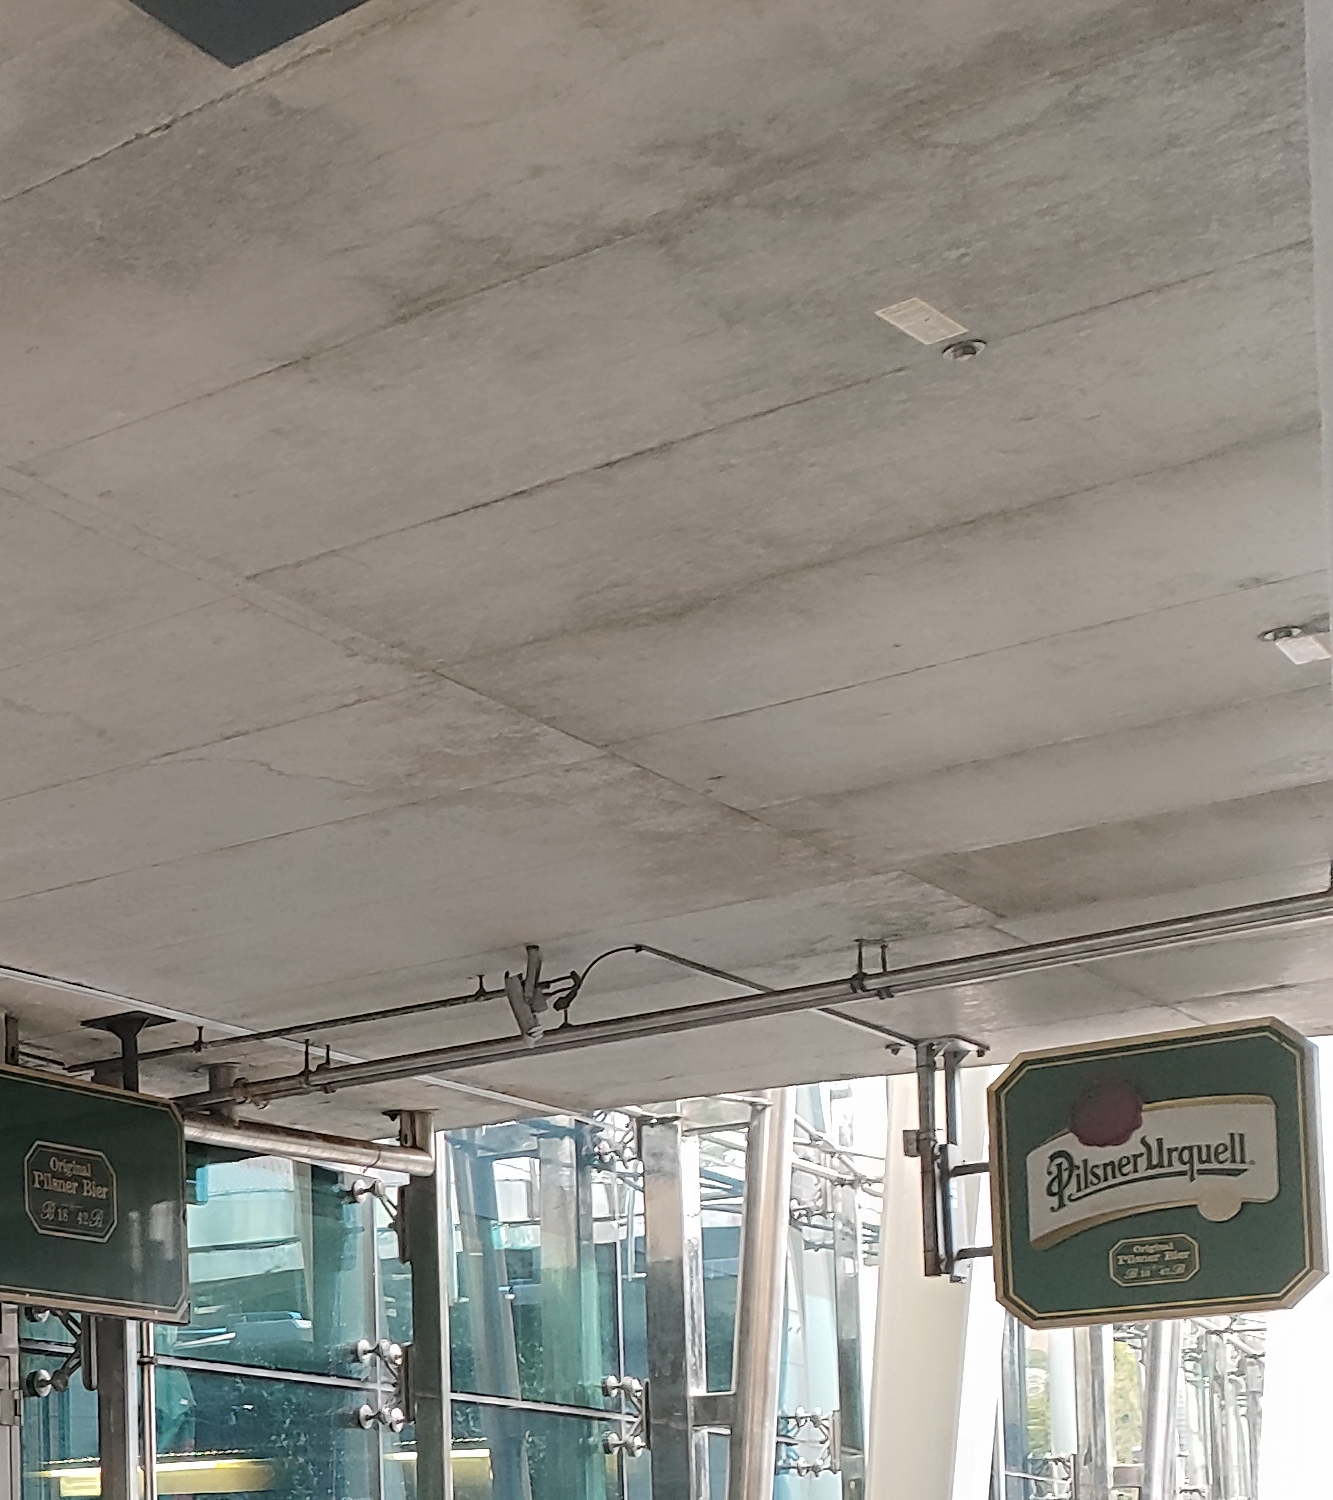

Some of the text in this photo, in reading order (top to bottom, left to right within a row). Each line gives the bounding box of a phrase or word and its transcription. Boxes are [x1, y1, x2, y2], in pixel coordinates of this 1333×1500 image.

[49, 1156, 92, 1178] Original
[1046, 1132, 1247, 1213] Pilsner Urquell
[32, 1170, 109, 1200] Pilsner Bier
